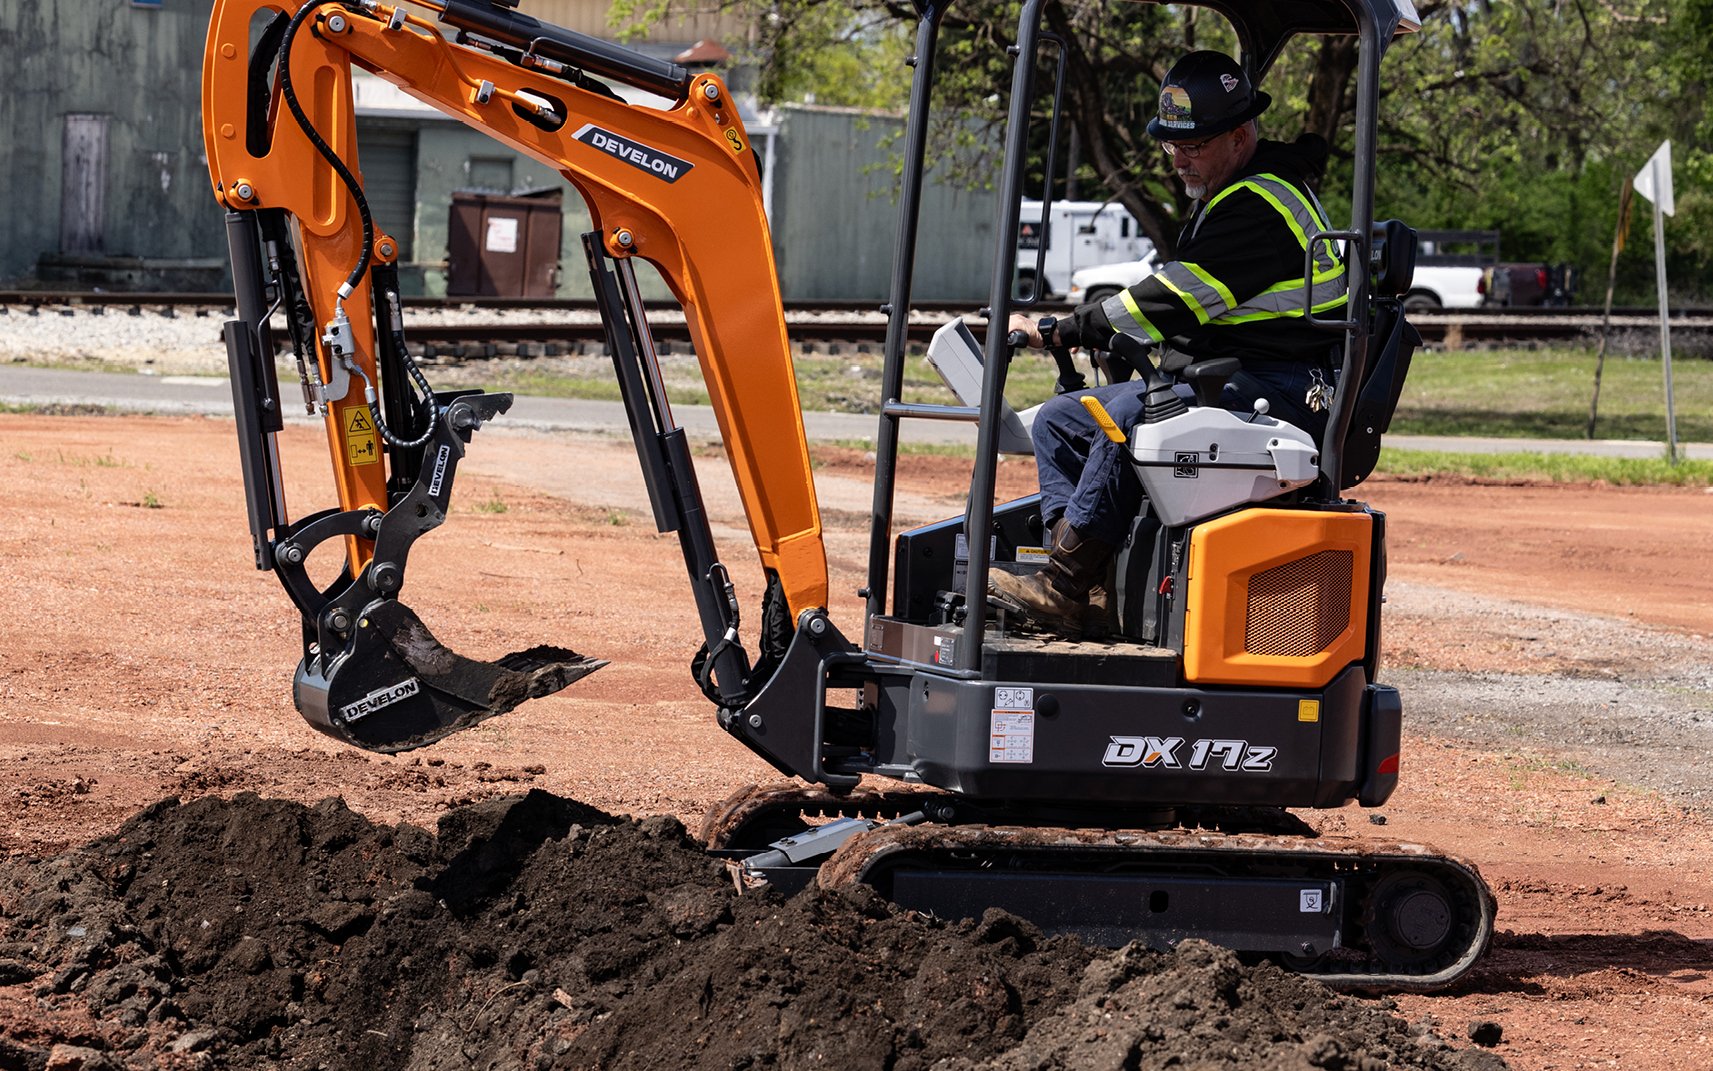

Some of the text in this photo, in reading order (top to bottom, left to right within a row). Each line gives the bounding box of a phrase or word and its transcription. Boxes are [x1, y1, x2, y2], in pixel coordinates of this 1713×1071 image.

[592, 132, 678, 179] DEVELON
[431, 447, 448, 494] DEVELON
[346, 682, 416, 718] DEVELON
[1102, 735, 1186, 769] DX
